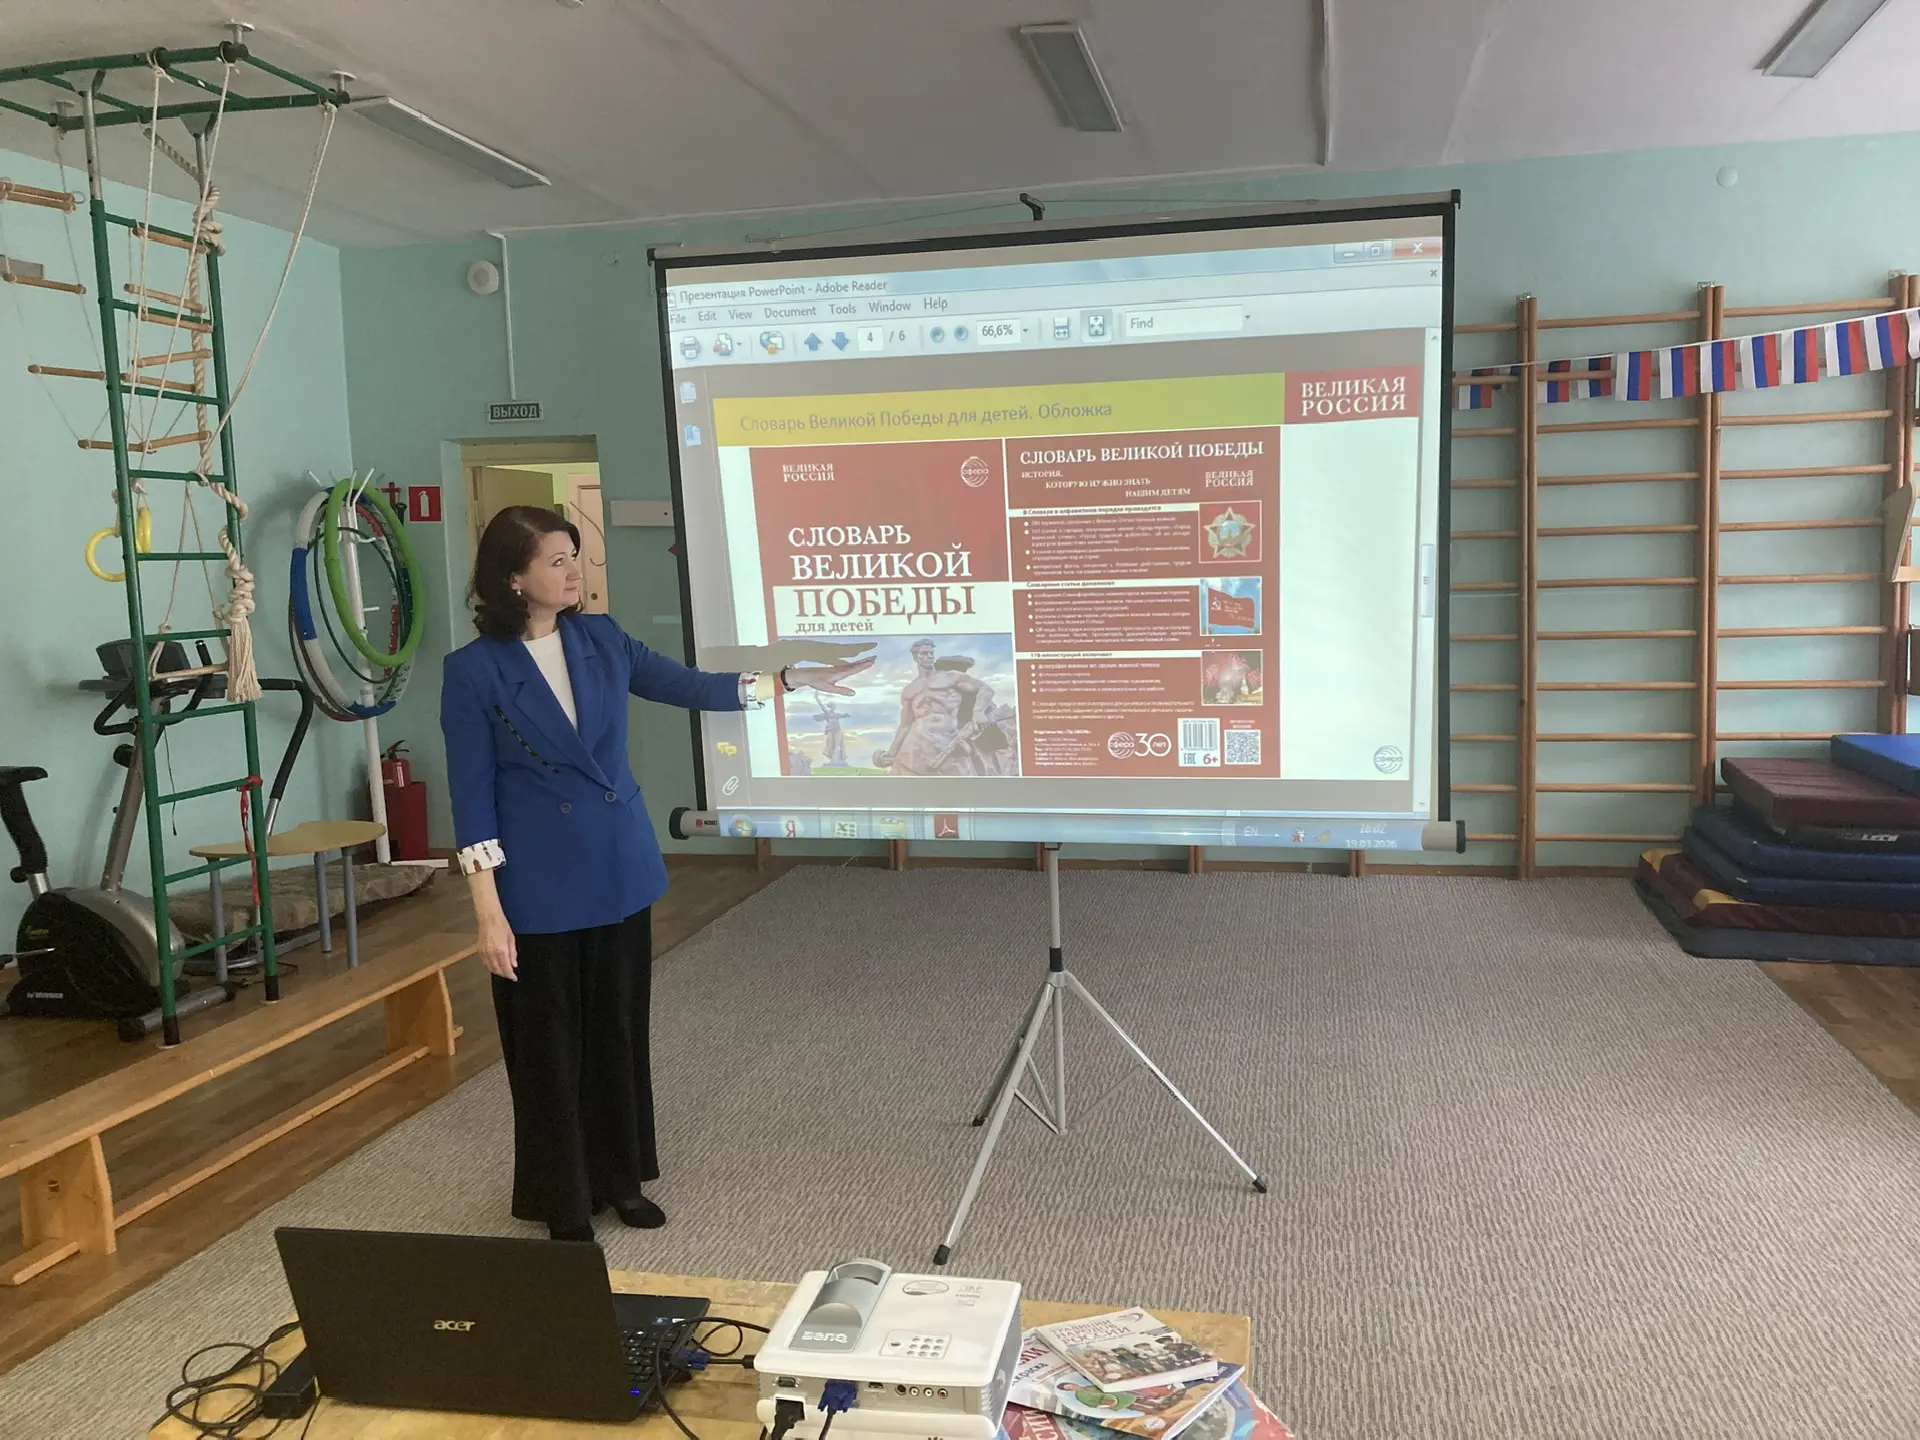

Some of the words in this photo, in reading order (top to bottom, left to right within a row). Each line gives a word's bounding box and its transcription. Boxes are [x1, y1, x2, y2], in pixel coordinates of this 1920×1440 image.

[680, 289, 746, 305] Презентация
[748, 284, 806, 298] PowerPoint
[815, 280, 849, 294] Adobe
[851, 279, 888, 292] Reader
[698, 310, 717, 322] Edit
[728, 309, 753, 320] View
[764, 305, 817, 319] Document
[828, 302, 857, 315] Tools
[868, 299, 911, 313] Window
[923, 296, 948, 312] Help
[1130, 316, 1154, 329] Find
[866, 331, 874, 343] 4
[899, 329, 906, 342] 6
[981, 323, 1013, 338] 66,6%
[1301, 376, 1406, 398] ВЕЛИКАЯ
[493, 405, 538, 418] ВЫХОД
[1301, 394, 1406, 416] РОССИЯ
[740, 415, 805, 433] Словарь
[810, 412, 875, 428] Великой
[880, 410, 943, 428] Победы
[947, 412, 976, 426] для
[980, 406, 1032, 424] детей.
[1038, 402, 1112, 419] Обложка
[1020, 448, 1096, 465] СЛОВАРЬ
[1101, 441, 1183, 461] ВЕЛИКОЙ
[1188, 441, 1264, 459] ПОБЕДЫ
[782, 463, 834, 473] ВЕЛИКАЯ
[1205, 470, 1254, 480] ВЕЛИКАЯ
[783, 472, 835, 482] РОССИЯ
[1205, 478, 1254, 488] РОССИЯ
[1045, 480, 1088, 489] КОТОРУЮ
[788, 525, 911, 548] СЛОВАРЬ
[790, 542, 972, 580] ВЕЛИКОЙ
[793, 586, 976, 625] ПОБЕДЫ
[796, 622, 825, 634] для
[829, 618, 874, 634] детей
[1203, 753, 1218, 765] 6+
[1243, 826, 1258, 837] EN
[434, 1319, 475, 1332] acer
